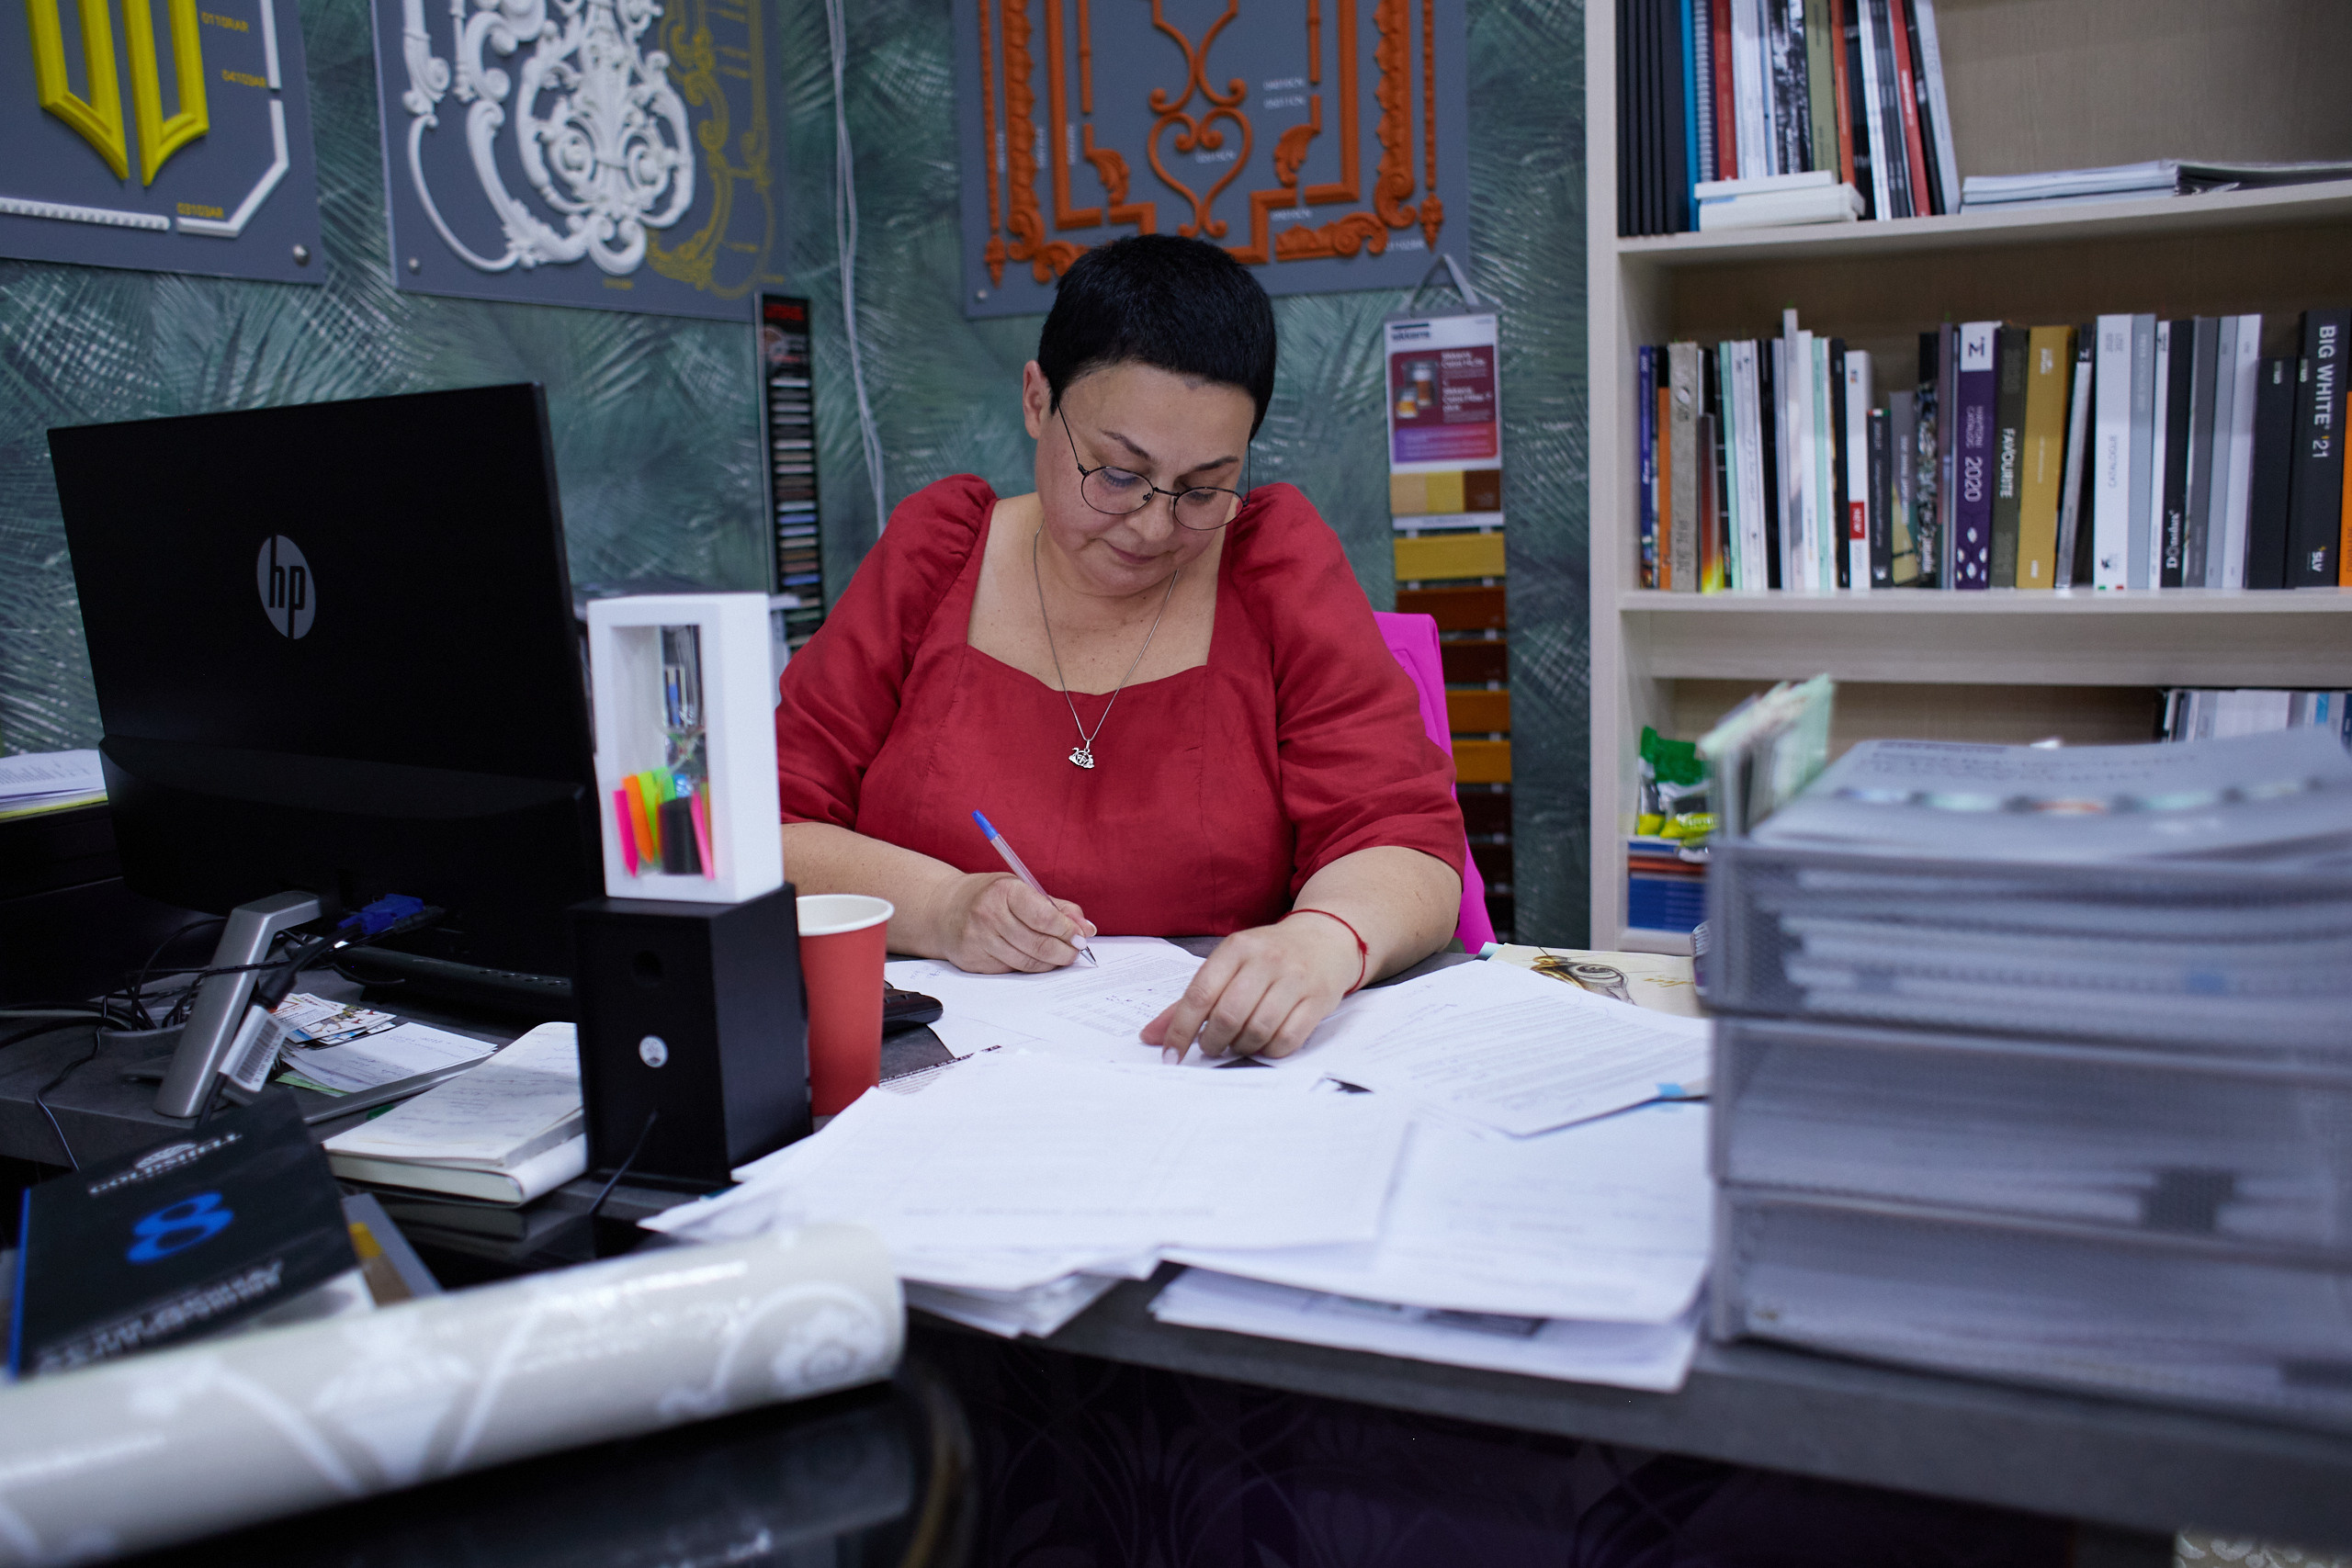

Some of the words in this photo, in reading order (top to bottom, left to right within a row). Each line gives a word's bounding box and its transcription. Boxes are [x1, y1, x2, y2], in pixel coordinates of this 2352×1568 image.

[2318, 325, 2335, 358] BIG
[2314, 364, 2334, 425] WHITE
[1964, 457, 1983, 502] 2020
[1999, 428, 2016, 499] FAVOURITE
[268, 535, 307, 639] hp
[2312, 550, 2323, 572] SLV
[126, 1191, 234, 1265] 8
